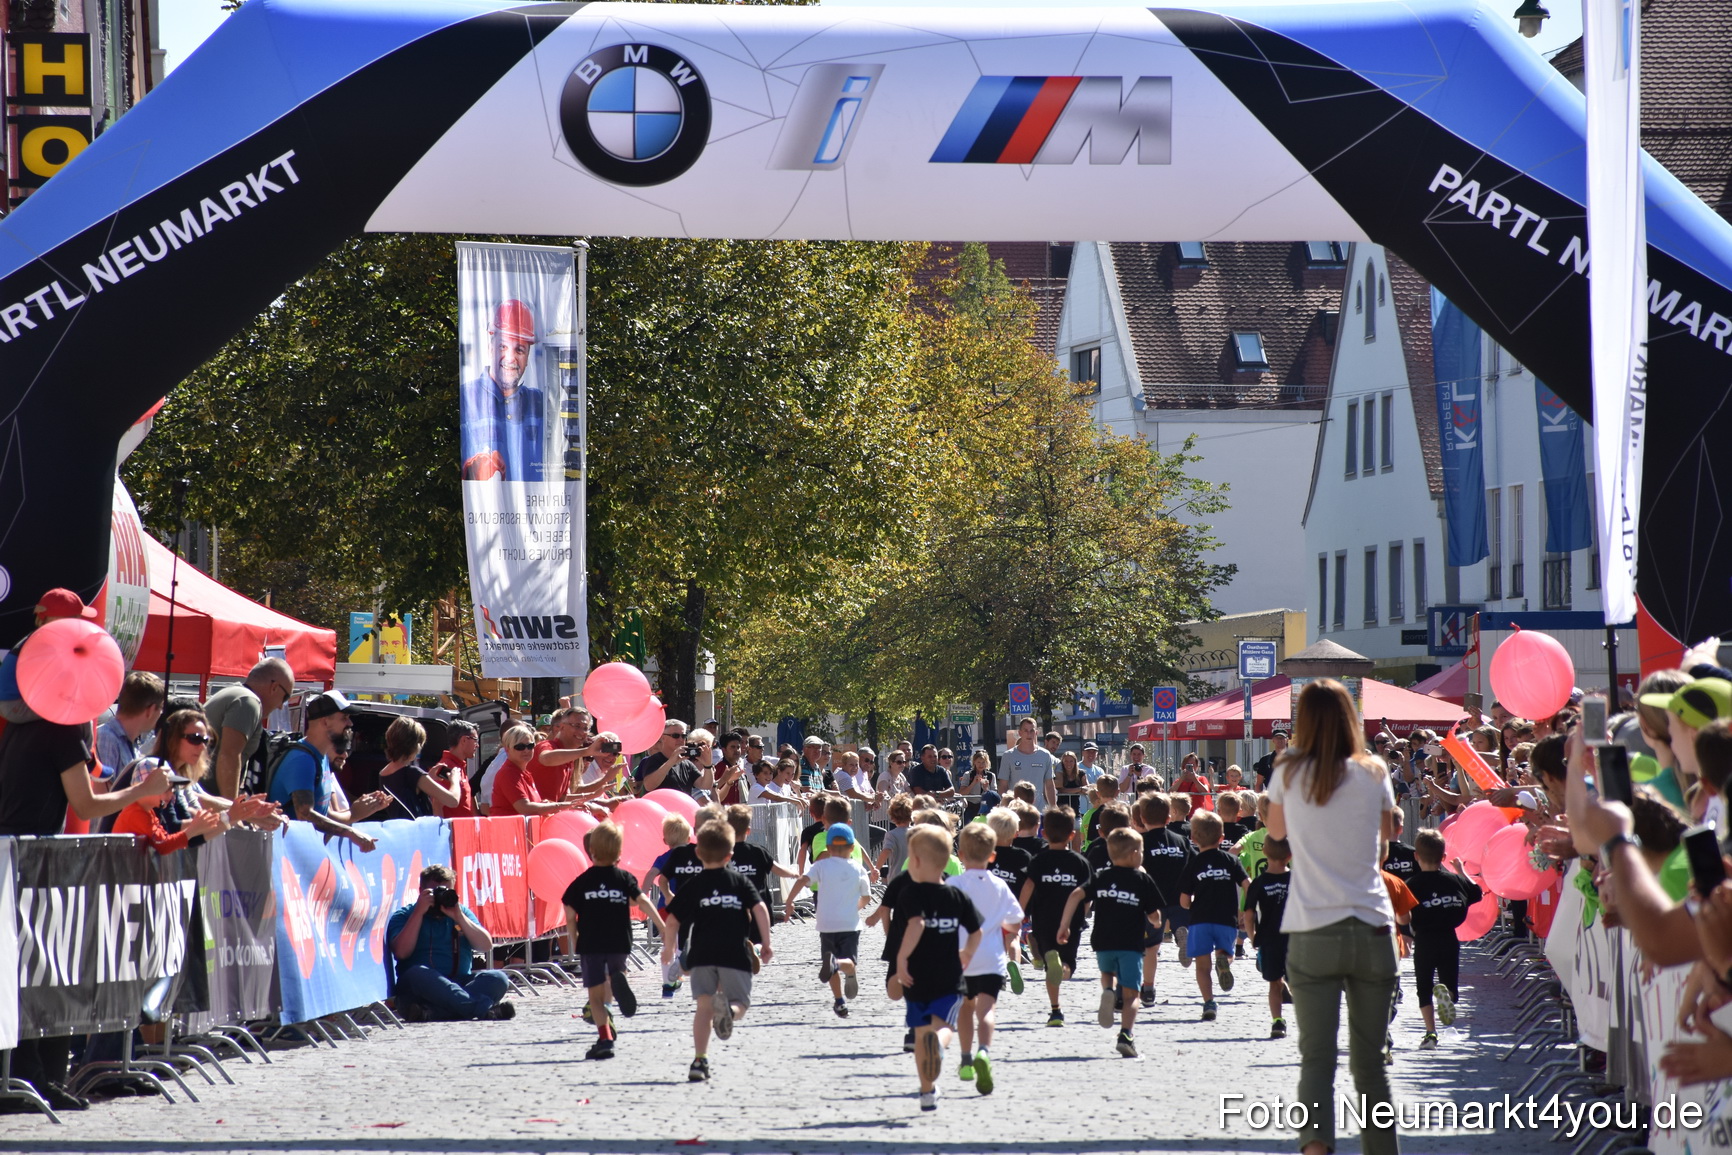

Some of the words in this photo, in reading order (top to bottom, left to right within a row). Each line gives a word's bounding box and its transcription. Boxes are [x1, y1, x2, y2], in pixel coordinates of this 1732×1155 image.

[574, 44, 698, 87] BMW
[1428, 163, 1550, 256] PARTL
[0, 280, 87, 343] RTL
[81, 149, 300, 293] NEUMARKT
[1012, 704, 1031, 712] TAXI
[1155, 711, 1175, 720] TAXI
[1391, 723, 1411, 731] Hotel
